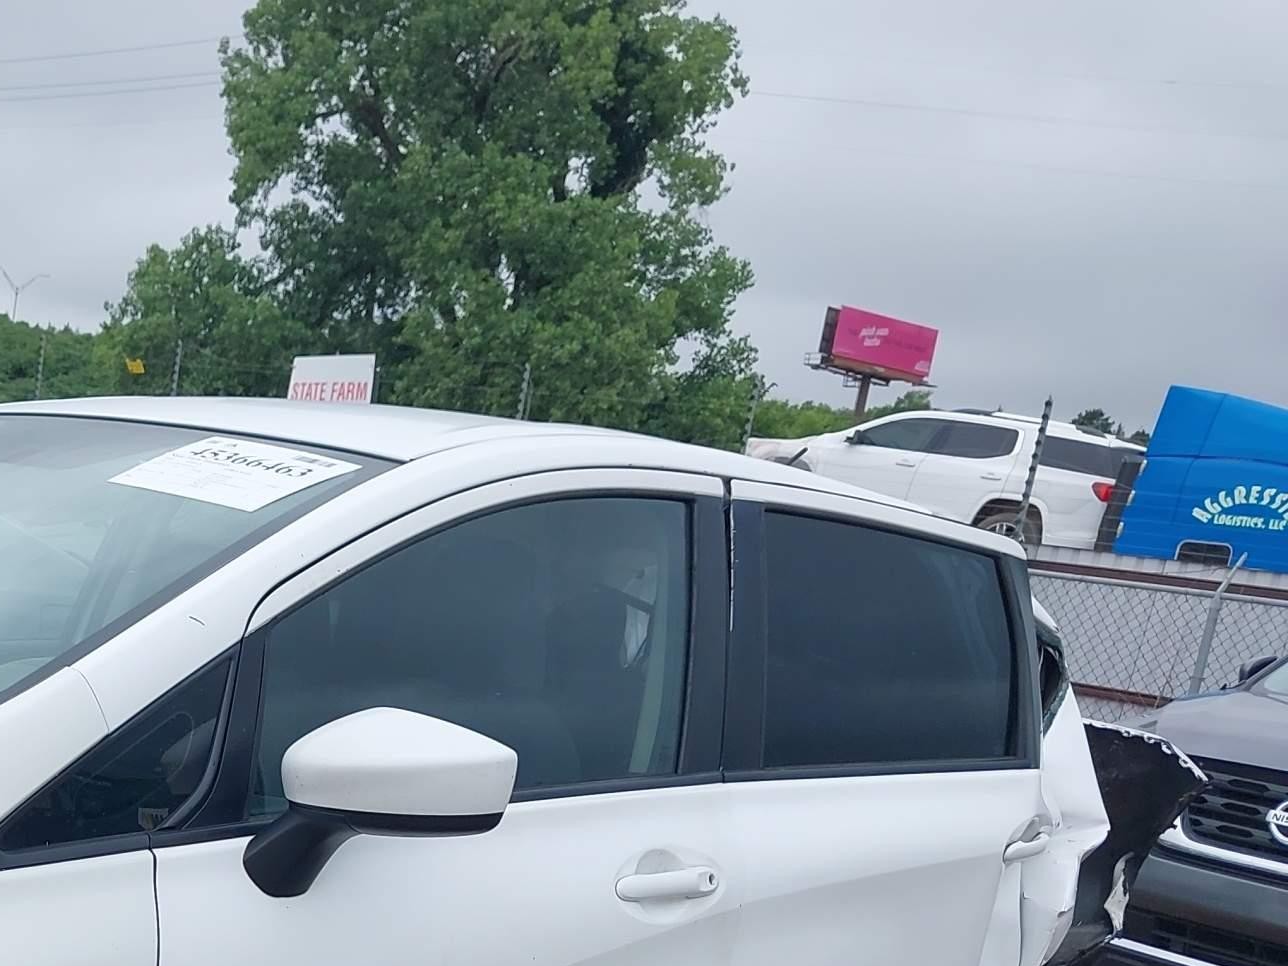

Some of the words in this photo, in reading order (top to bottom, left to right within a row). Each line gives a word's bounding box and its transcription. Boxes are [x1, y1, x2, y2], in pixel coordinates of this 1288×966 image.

[292, 382, 326, 401] STATE
[331, 382, 368, 401] FARM
[189, 448, 313, 477] 45366463
